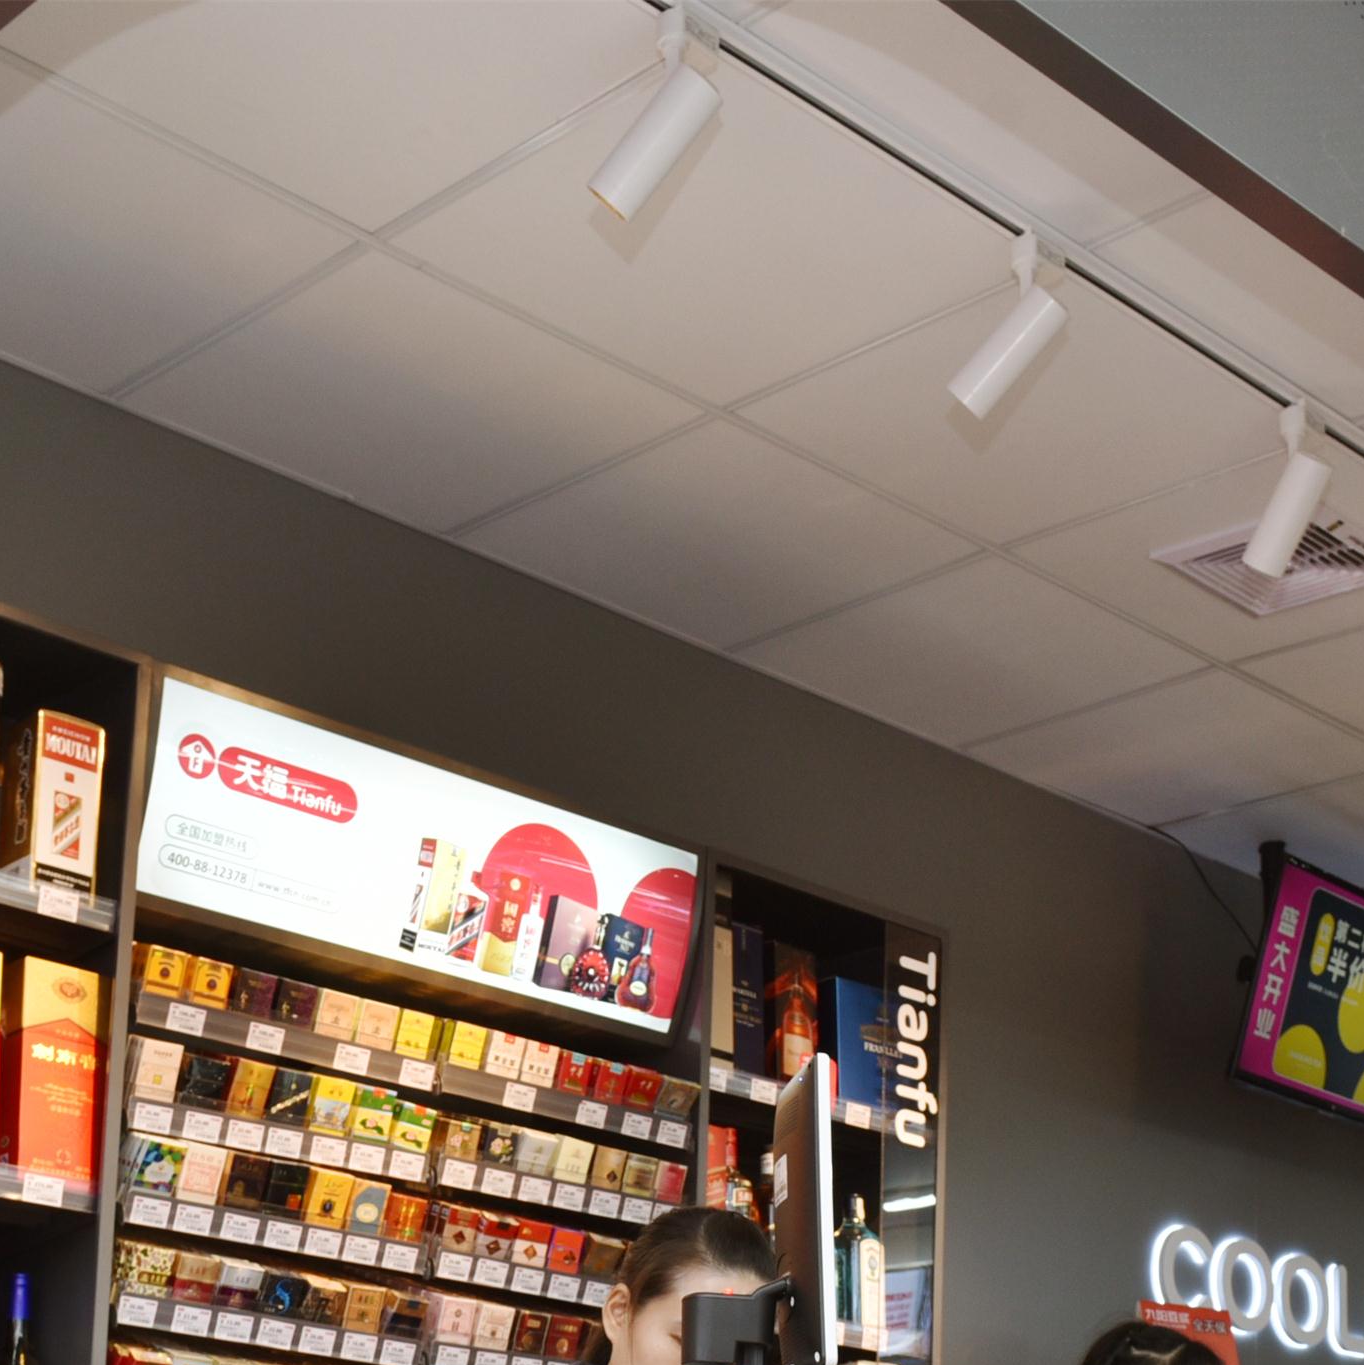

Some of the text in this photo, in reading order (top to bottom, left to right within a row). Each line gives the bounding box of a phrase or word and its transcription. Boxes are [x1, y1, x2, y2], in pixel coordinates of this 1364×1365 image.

[234, 754, 342, 816] 天福 Tianfu
[1253, 905, 1300, 1040] 盛大开业
[894, 951, 938, 1148] Tianfu
